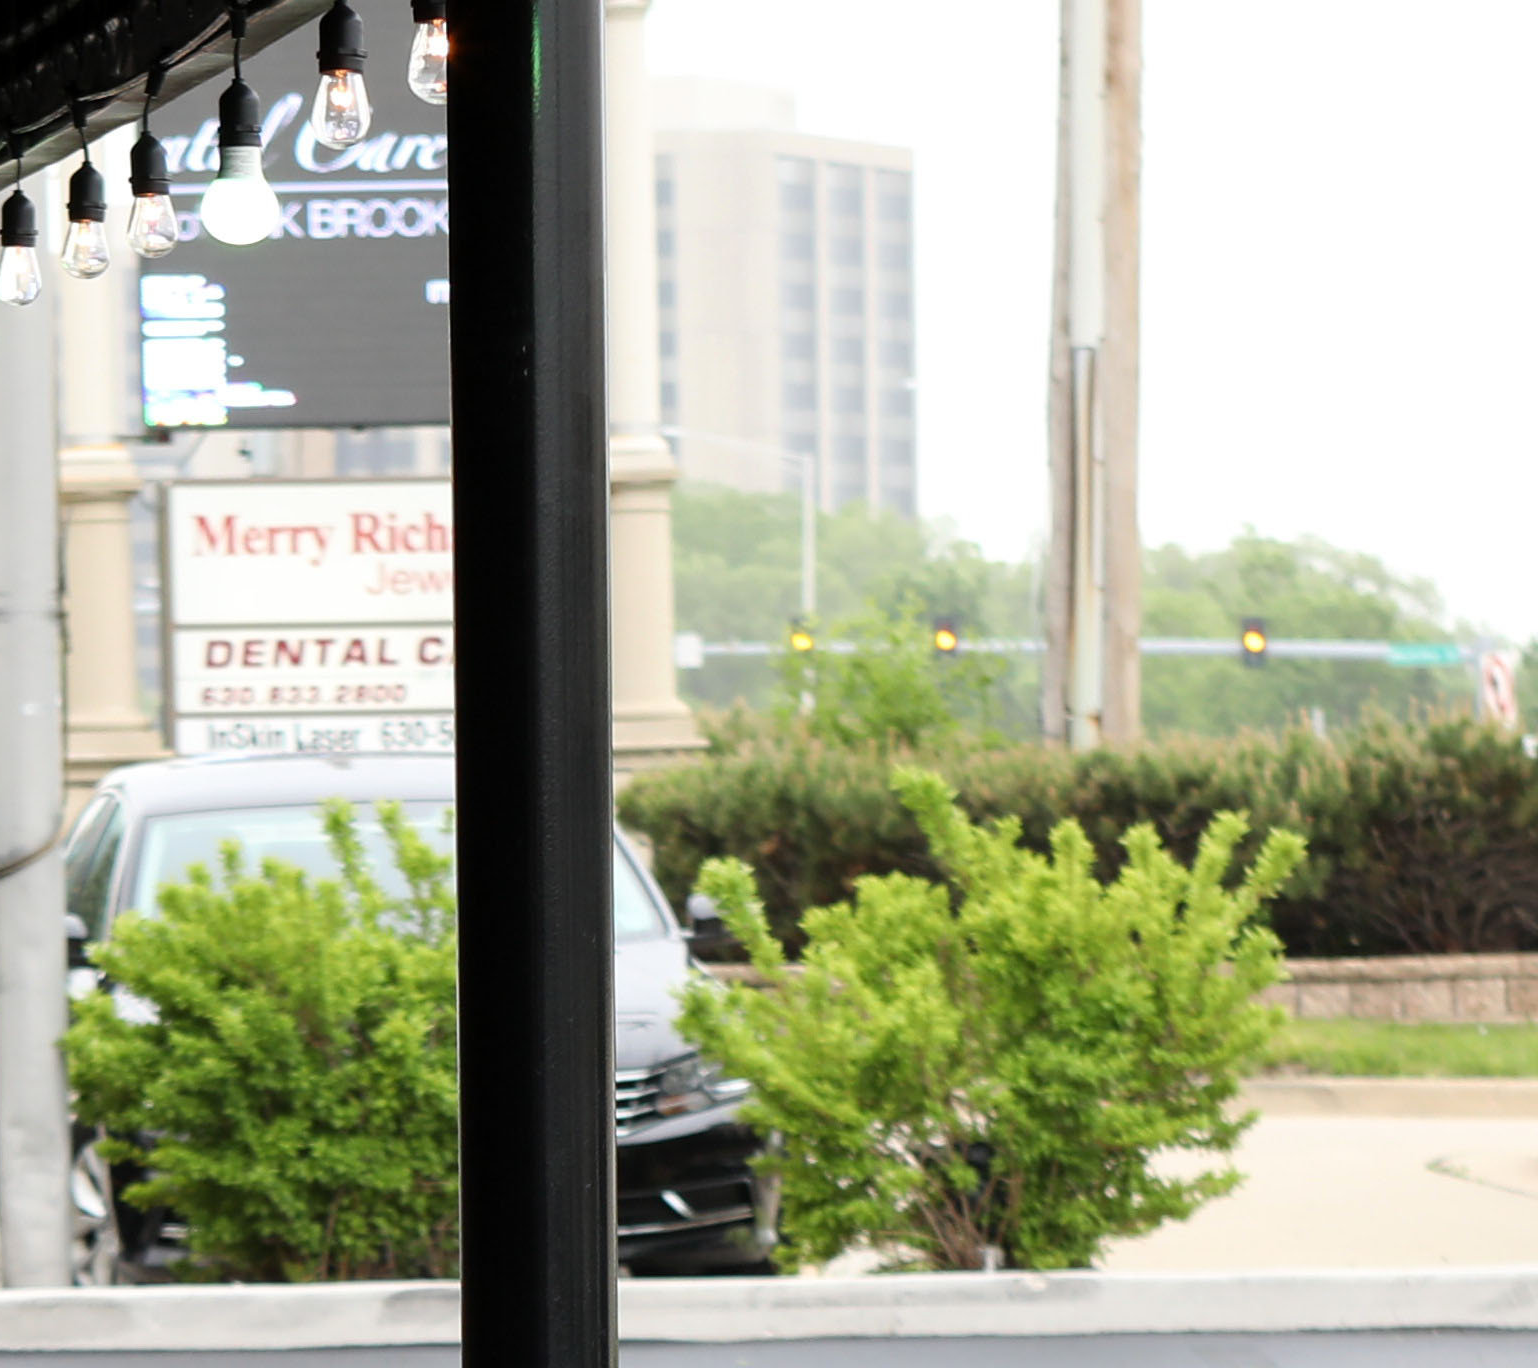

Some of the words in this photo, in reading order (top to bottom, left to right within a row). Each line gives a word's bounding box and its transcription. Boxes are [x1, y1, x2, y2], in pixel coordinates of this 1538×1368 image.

[306, 198, 449, 240] BROOK
[191, 513, 334, 567] Merry
[203, 637, 399, 670] DENTAL
[416, 635, 454, 667] C
[294, 722, 362, 751] Laser
